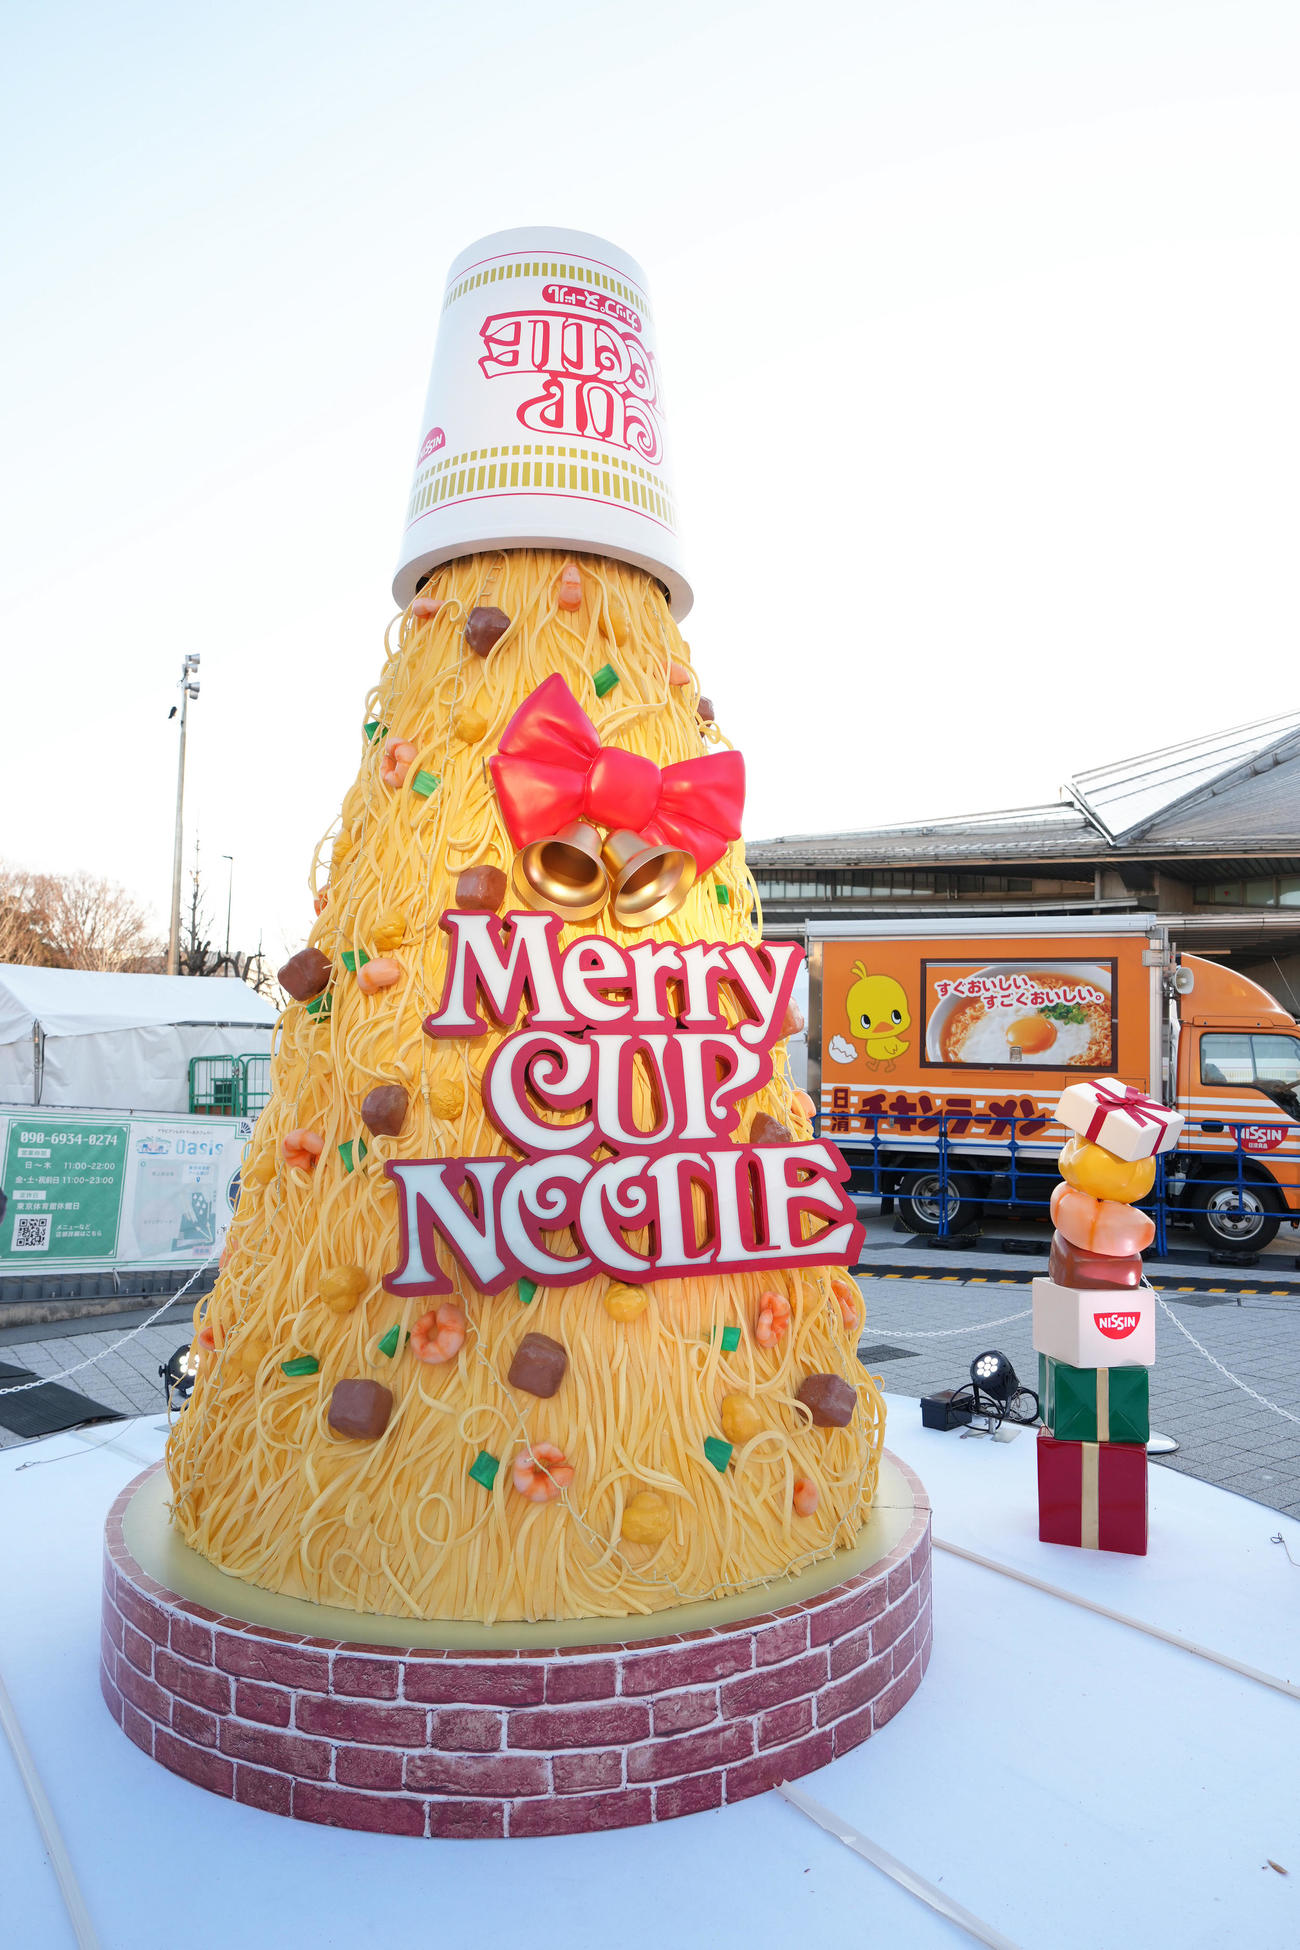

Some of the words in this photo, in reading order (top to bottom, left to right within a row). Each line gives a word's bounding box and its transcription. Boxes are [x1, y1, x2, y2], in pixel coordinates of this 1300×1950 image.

[547, 285, 639, 330] カップヌードル
[516, 377, 663, 466] CUP
[426, 911, 801, 1044] Merry
[937, 975, 1036, 997] すぐおいしい、
[983, 987, 1102, 1010] すごくおいしい。
[486, 1029, 767, 1152] CUP
[831, 1088, 849, 1132] 日清
[858, 1094, 1046, 1136] チキンラーメン
[1235, 1125, 1282, 1142] NISSIN
[20, 1131, 118, 1146] 090-6934-0274
[176, 1138, 224, 1156] Oasis
[388, 1141, 860, 1290] NOODLE
[1099, 1314, 1136, 1331] NISSIN
